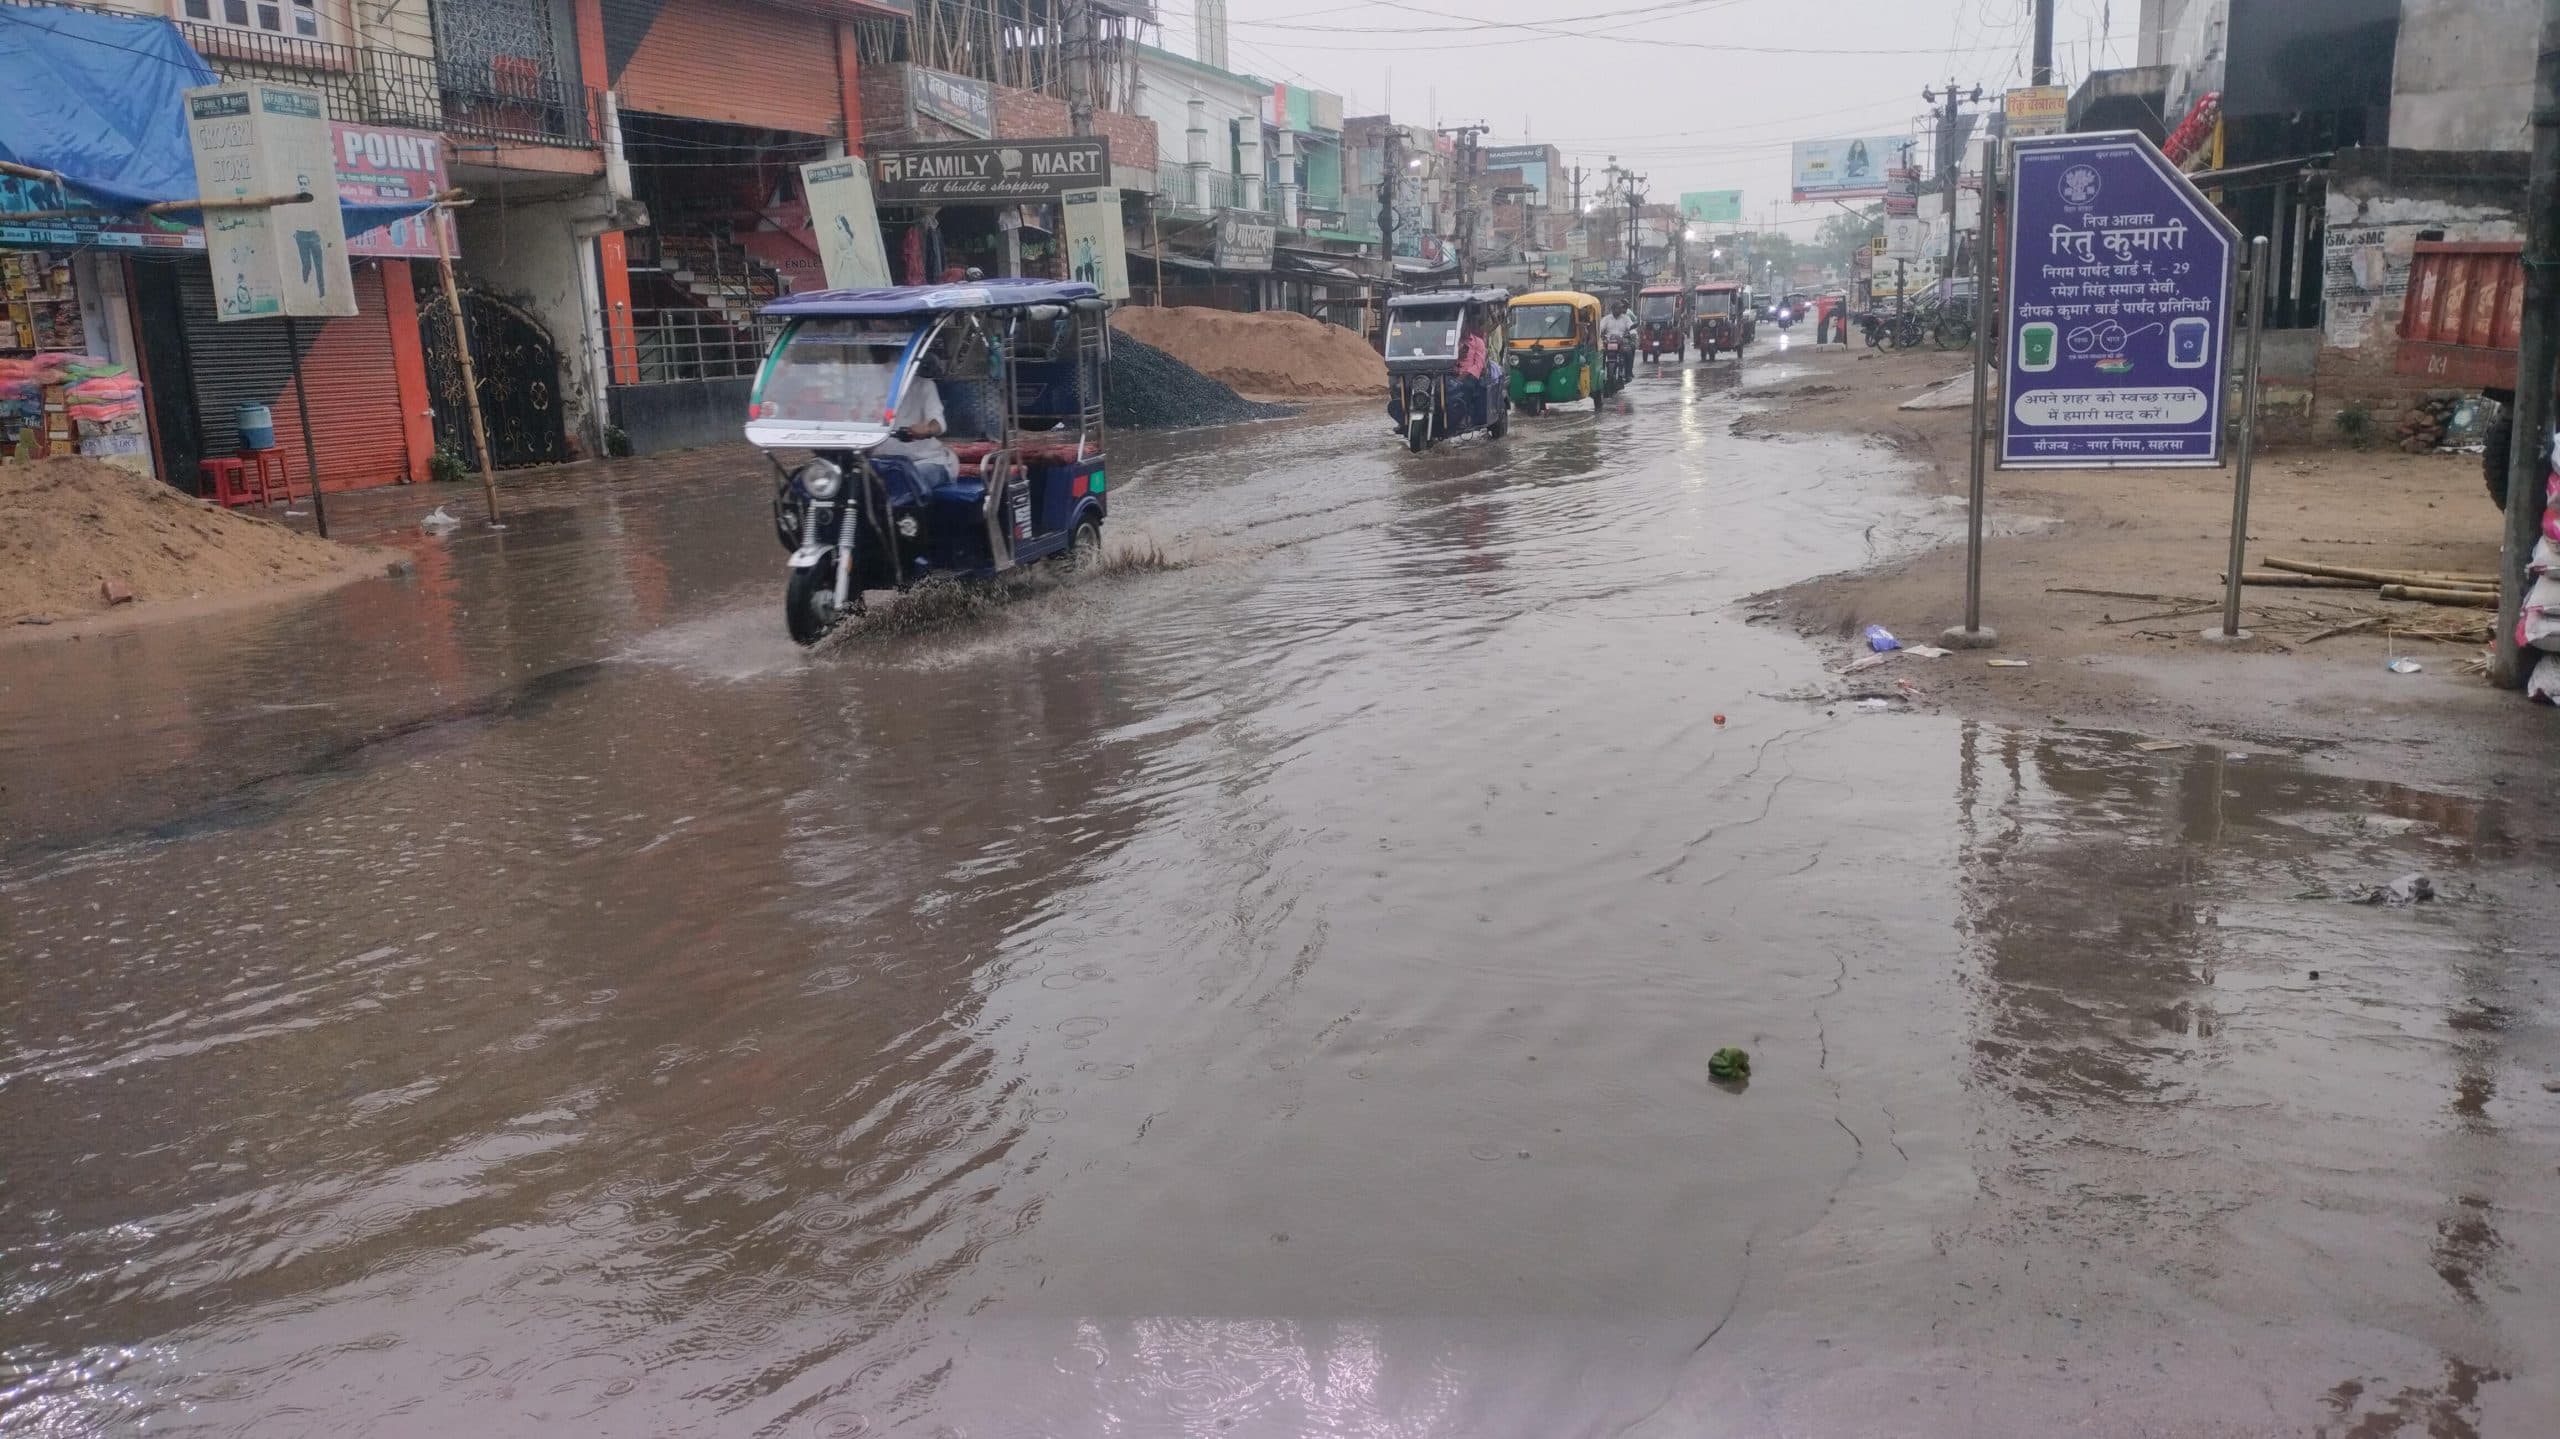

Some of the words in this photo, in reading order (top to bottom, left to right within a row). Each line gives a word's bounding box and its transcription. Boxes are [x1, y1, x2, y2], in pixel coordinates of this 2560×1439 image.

[343, 130, 437, 174] POINT
[905, 155, 989, 177] FAMILY
[1032, 151, 1100, 174] MART
[920, 181, 938, 193] dil
[943, 180, 986, 193] khulke
[990, 180, 1049, 193] shopping
[2083, 213, 2108, 228] निज
[2112, 214, 2154, 227] आवास
[2049, 224, 2095, 262] रितु
[2101, 218, 2188, 261] कुमारी
[2358, 231, 2385, 245] SMC
[785, 259, 821, 269] ENDLE
[2042, 265, 2074, 278] निगम
[2079, 263, 2110, 277] पार्षद
[2114, 261, 2139, 276] वार्ड
[2172, 262, 2190, 275] 29
[2051, 283, 2078, 297] रमेश
[2083, 282, 2105, 297] सिंह
[2109, 283, 2145, 296] समाज
[2149, 279, 2180, 296] सेवी,
[2019, 302, 2053, 318] दीपक
[2057, 304, 2091, 320] कुमार
[2095, 299, 2119, 315] वार्ड
[2123, 299, 2154, 314] पार्षद
[2159, 297, 2211, 313] प्रतिनिधी
[2025, 391, 2057, 404] अपने
[2063, 394, 2089, 405] शहर
[2096, 390, 2115, 403] को
[2120, 393, 2158, 403] स्वच्छ
[2163, 389, 2197, 402] रखने
[2048, 408, 2058, 421] में
[2063, 408, 2099, 421] हमारी
[2104, 410, 2134, 420] मदद
[2033, 438, 2068, 451] सौजन्य
[2087, 441, 2108, 450] नगर
[2112, 438, 2145, 451] निगम,
[2148, 439, 2184, 450] सहरसा
